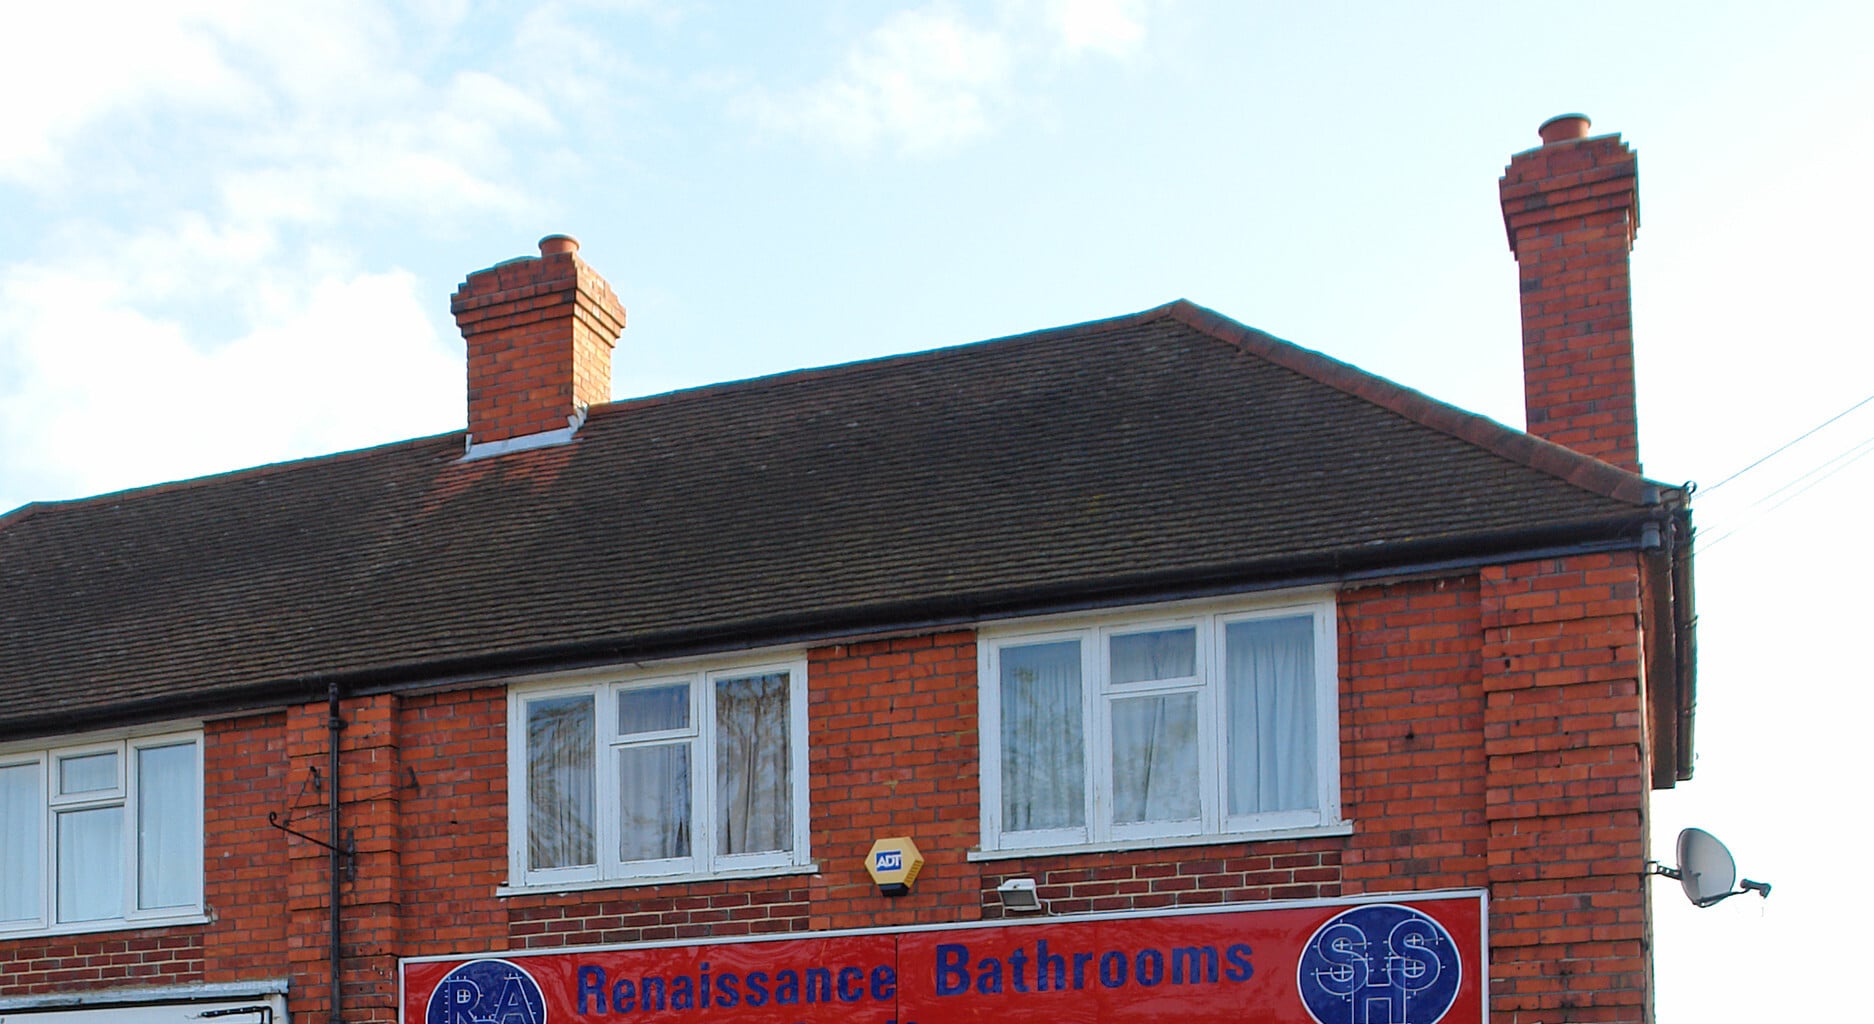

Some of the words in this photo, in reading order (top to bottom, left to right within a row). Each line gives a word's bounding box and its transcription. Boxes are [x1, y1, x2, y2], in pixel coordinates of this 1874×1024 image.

[876, 855, 902, 868] ADT
[577, 962, 896, 1015] Renaissance
[936, 940, 1254, 997] Bathrooms
